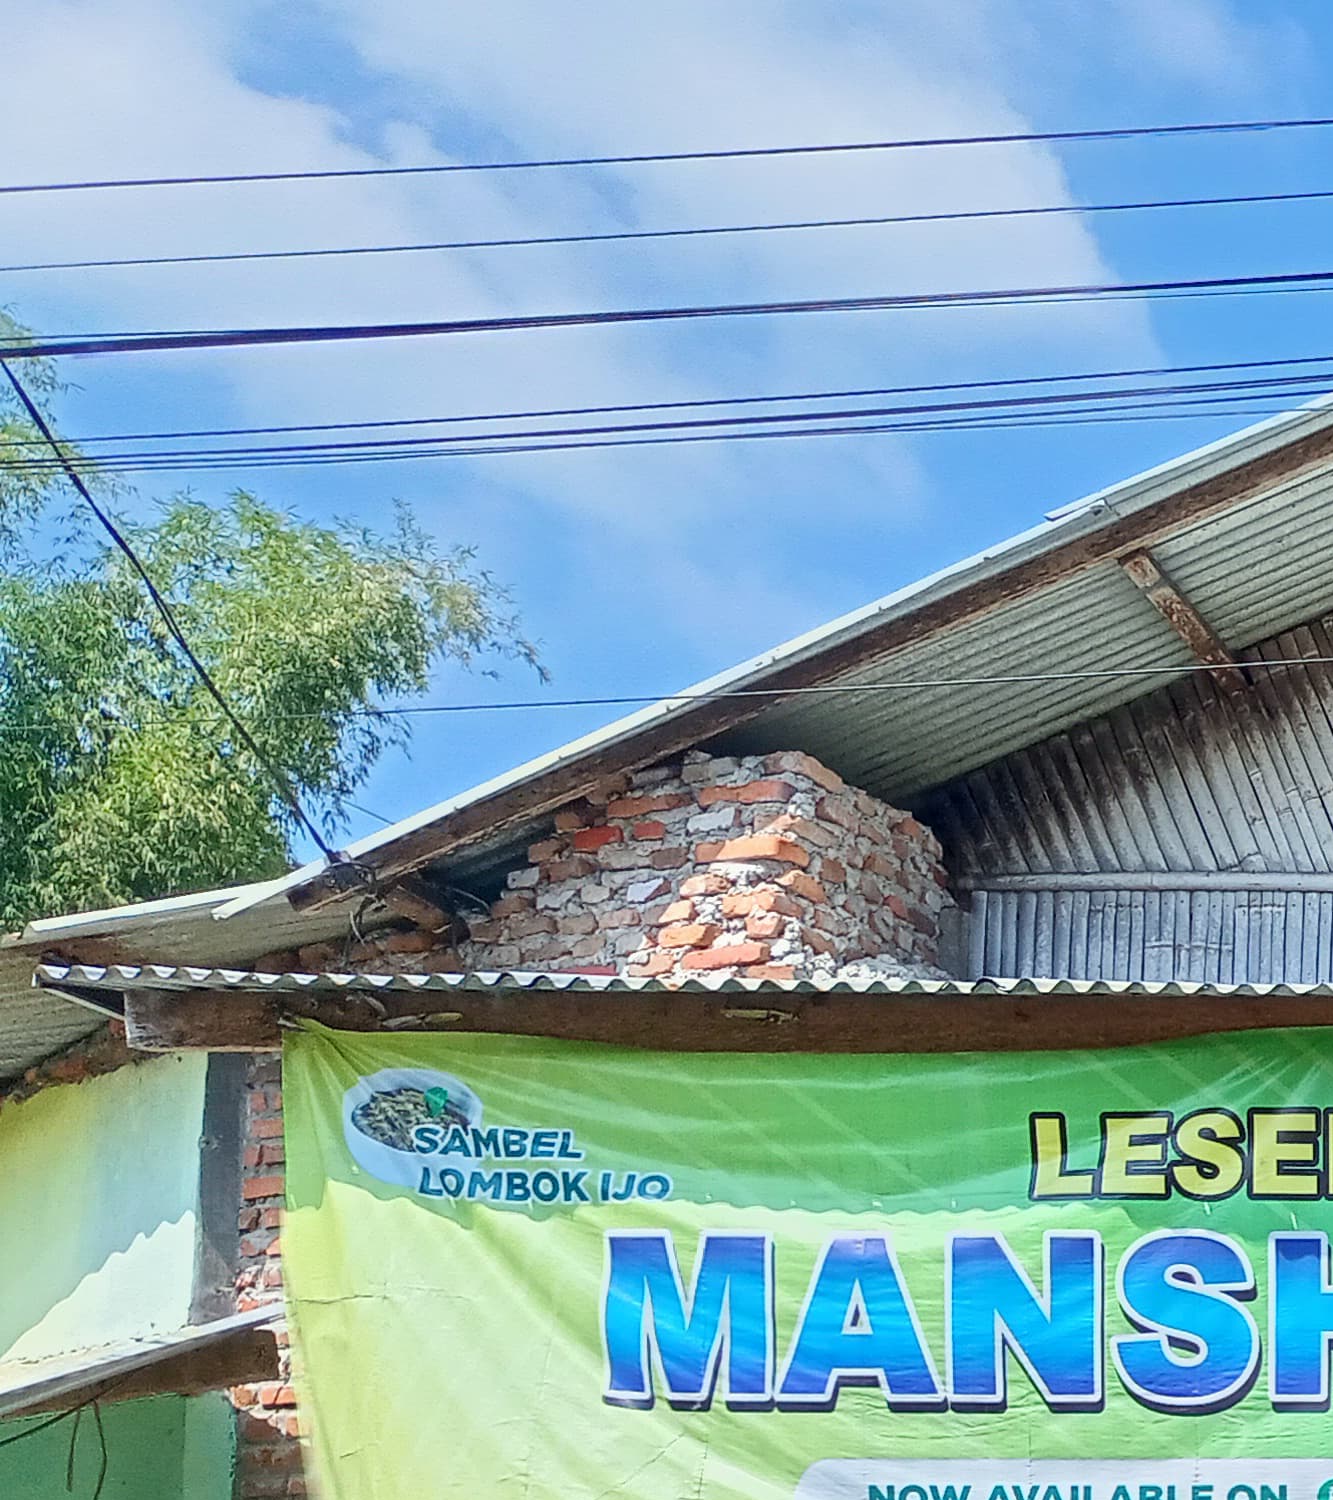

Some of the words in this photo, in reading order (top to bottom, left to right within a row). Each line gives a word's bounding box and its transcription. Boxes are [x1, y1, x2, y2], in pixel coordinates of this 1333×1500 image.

[412, 1126, 583, 1160] SAMBEL
[417, 1166, 590, 1202] LOMBOK
[599, 1172, 671, 1201] IJO
